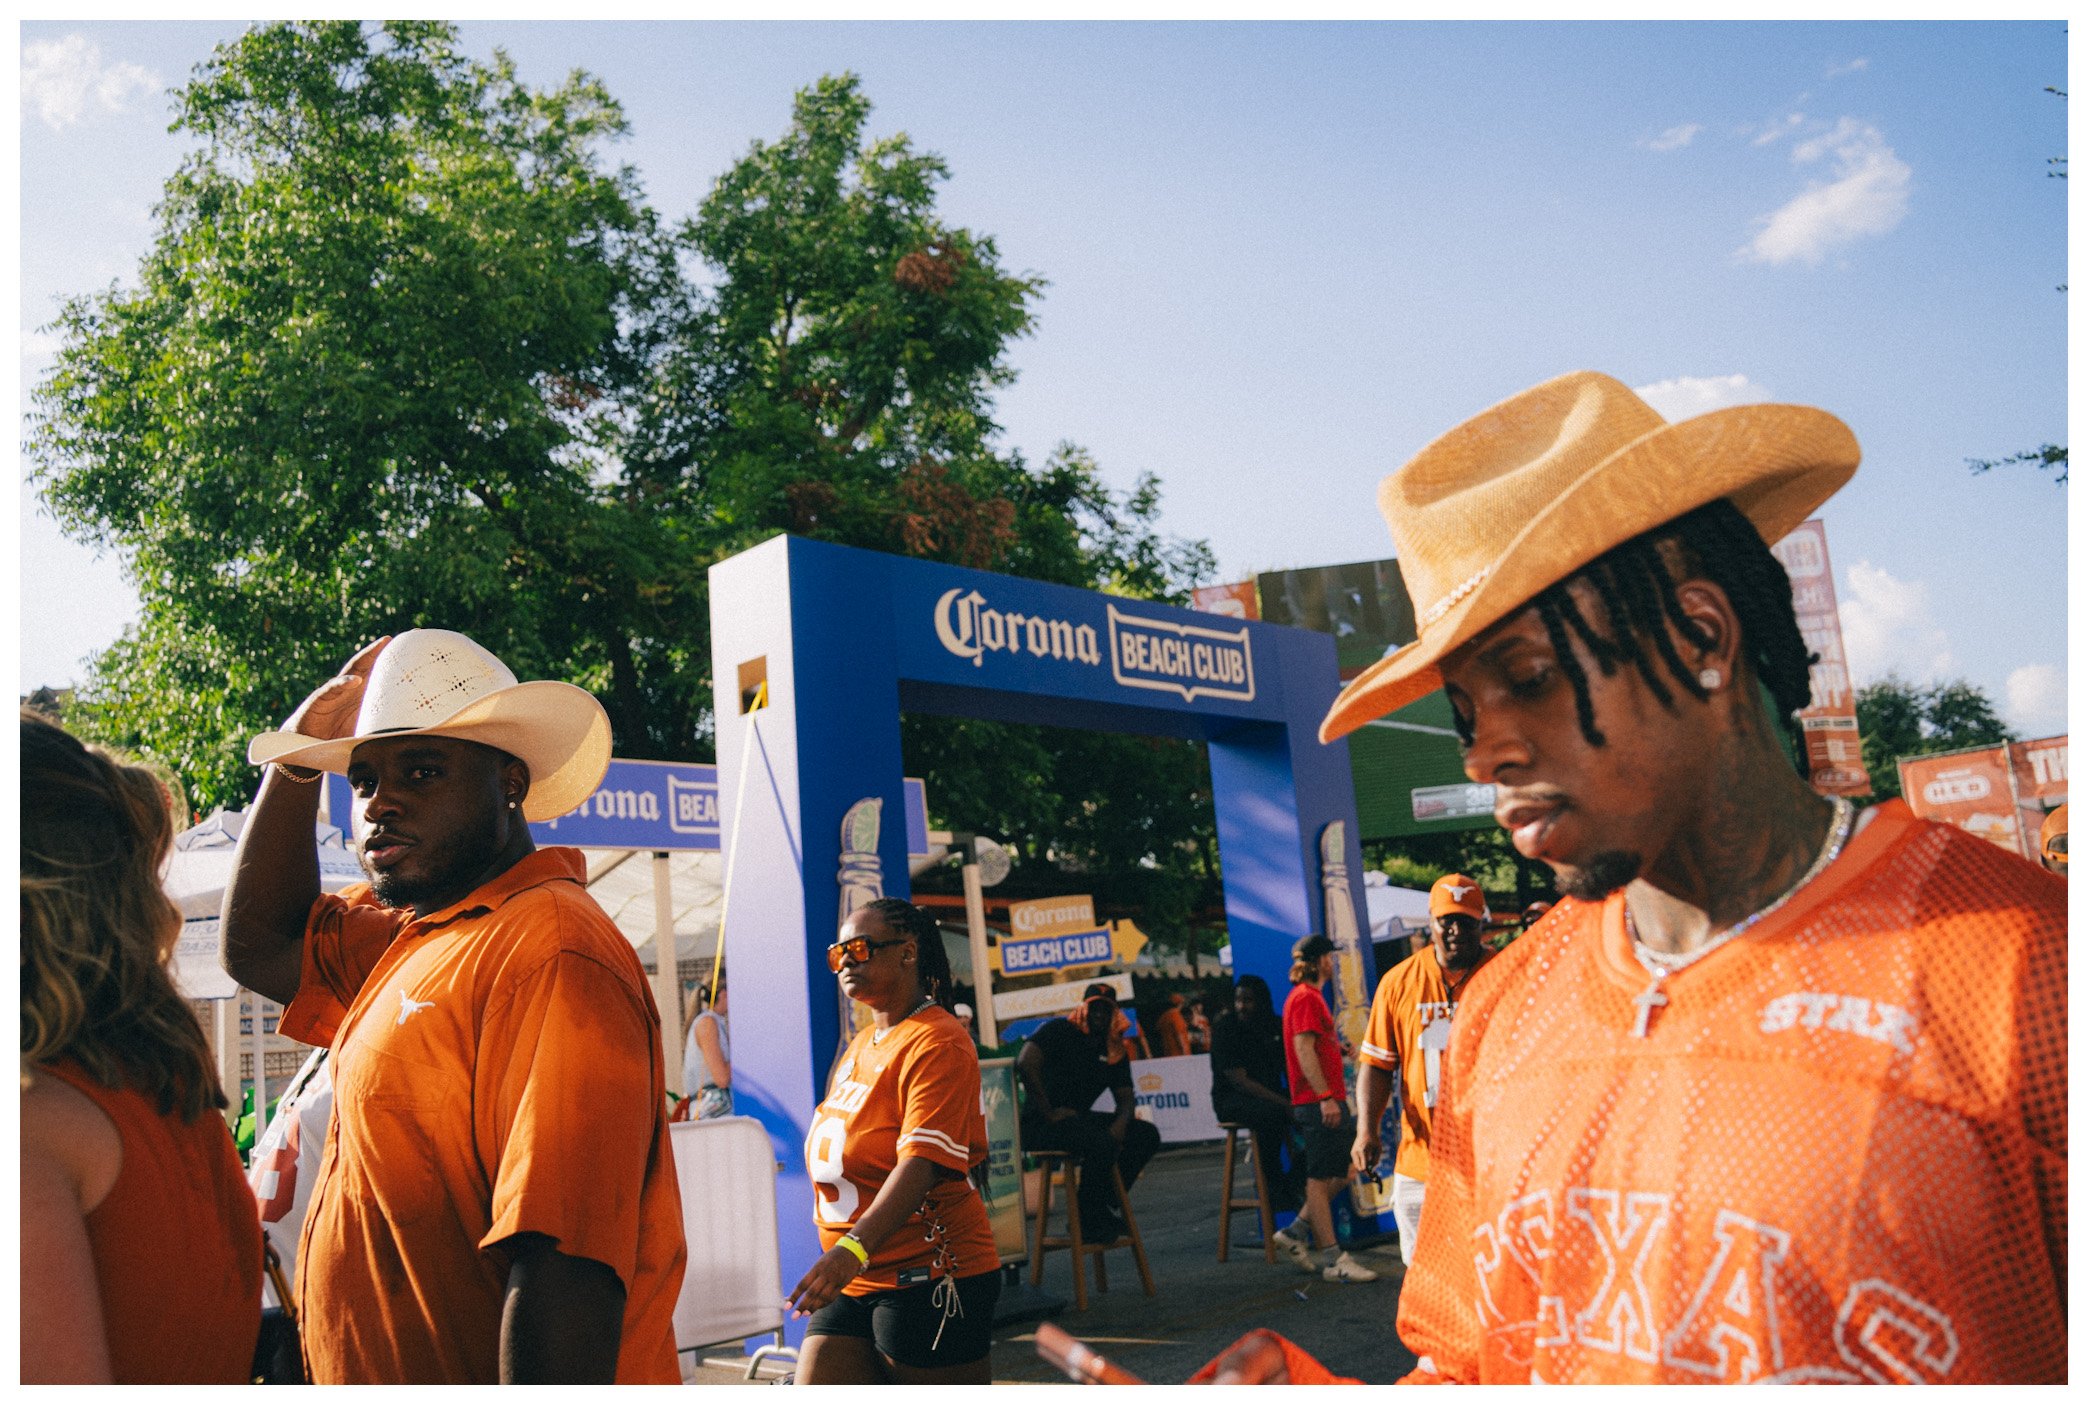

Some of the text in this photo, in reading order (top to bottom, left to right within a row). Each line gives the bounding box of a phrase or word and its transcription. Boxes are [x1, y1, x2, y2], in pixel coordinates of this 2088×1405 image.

[933, 588, 1101, 667] Corona
[1120, 631, 1246, 685] BEACH CLUB
[547, 788, 662, 829] rona
[679, 793, 720, 822] BEA
[1014, 905, 1093, 933] Corona
[1006, 935, 1110, 969] BEACH CLUB
[1135, 1091, 1190, 1110] orona
